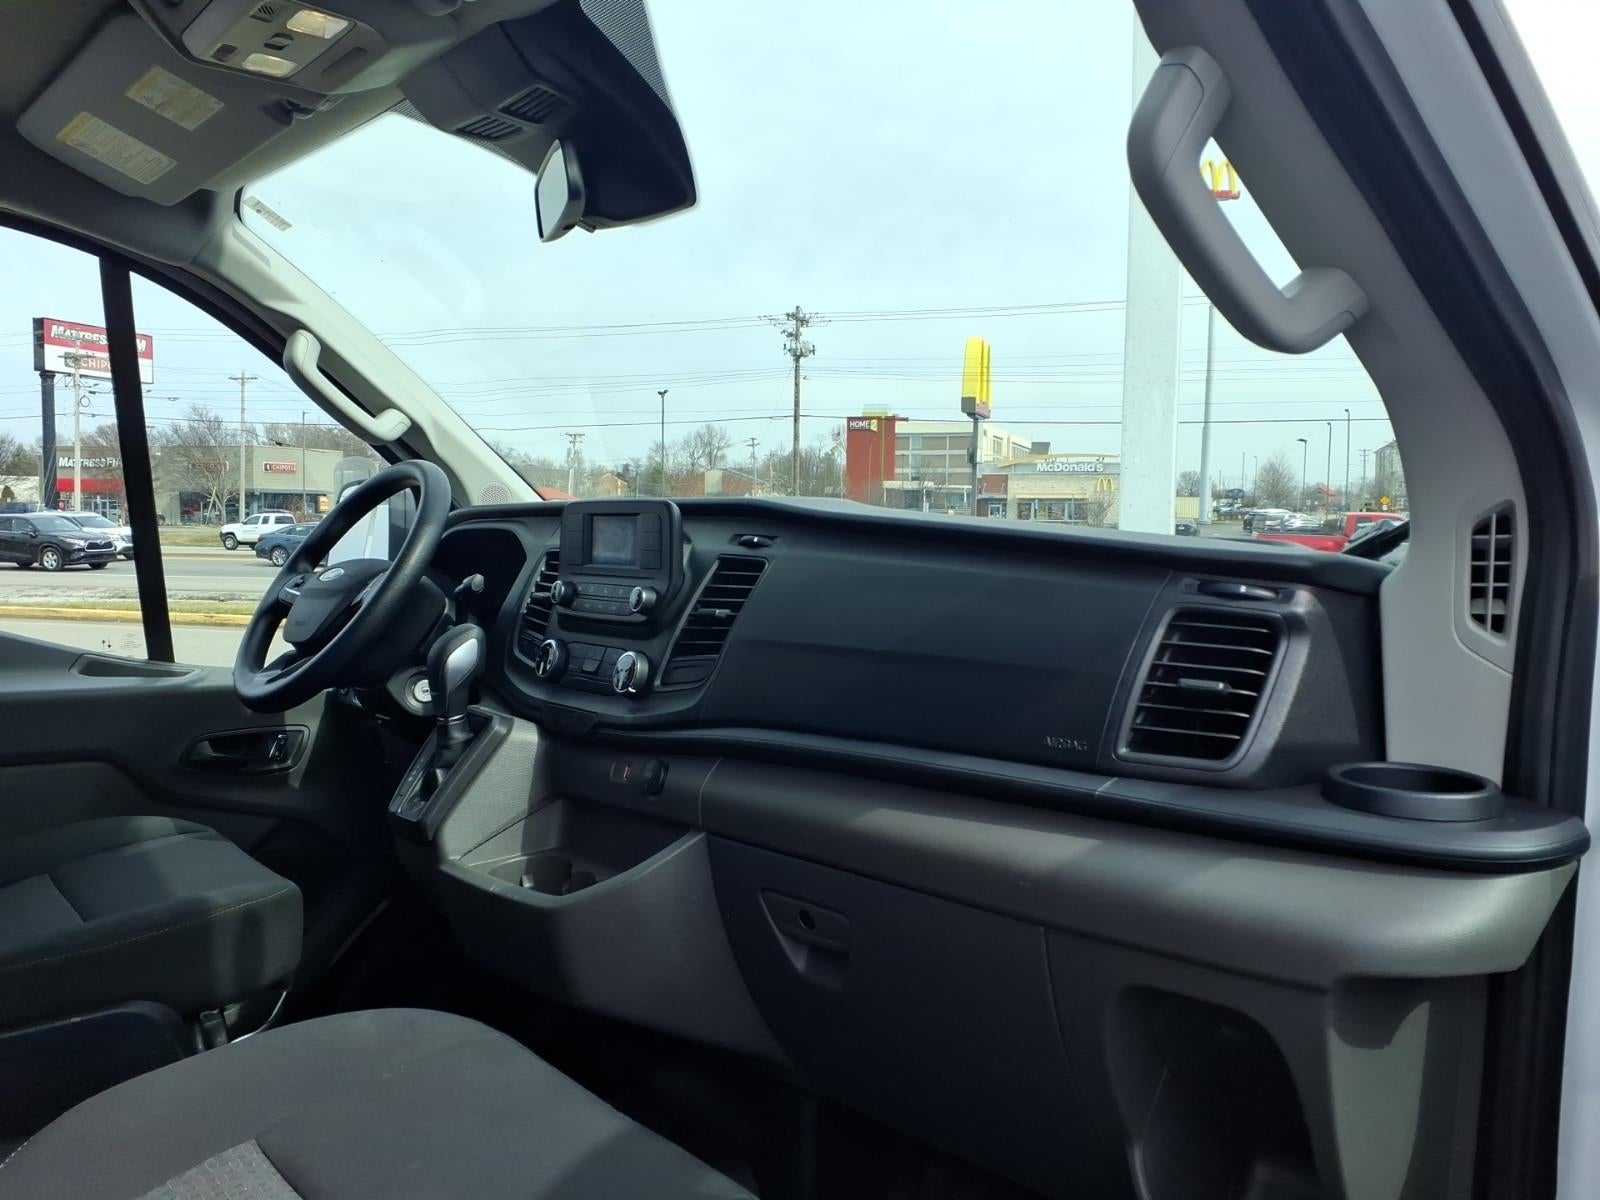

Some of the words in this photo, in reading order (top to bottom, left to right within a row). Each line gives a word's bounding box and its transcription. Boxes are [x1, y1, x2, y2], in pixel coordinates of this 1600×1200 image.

[50, 325, 108, 344] MATTRES
[80, 357, 111, 370] CHIP
[849, 420, 870, 428] HOME
[1036, 463, 1104, 472] McDonald's
